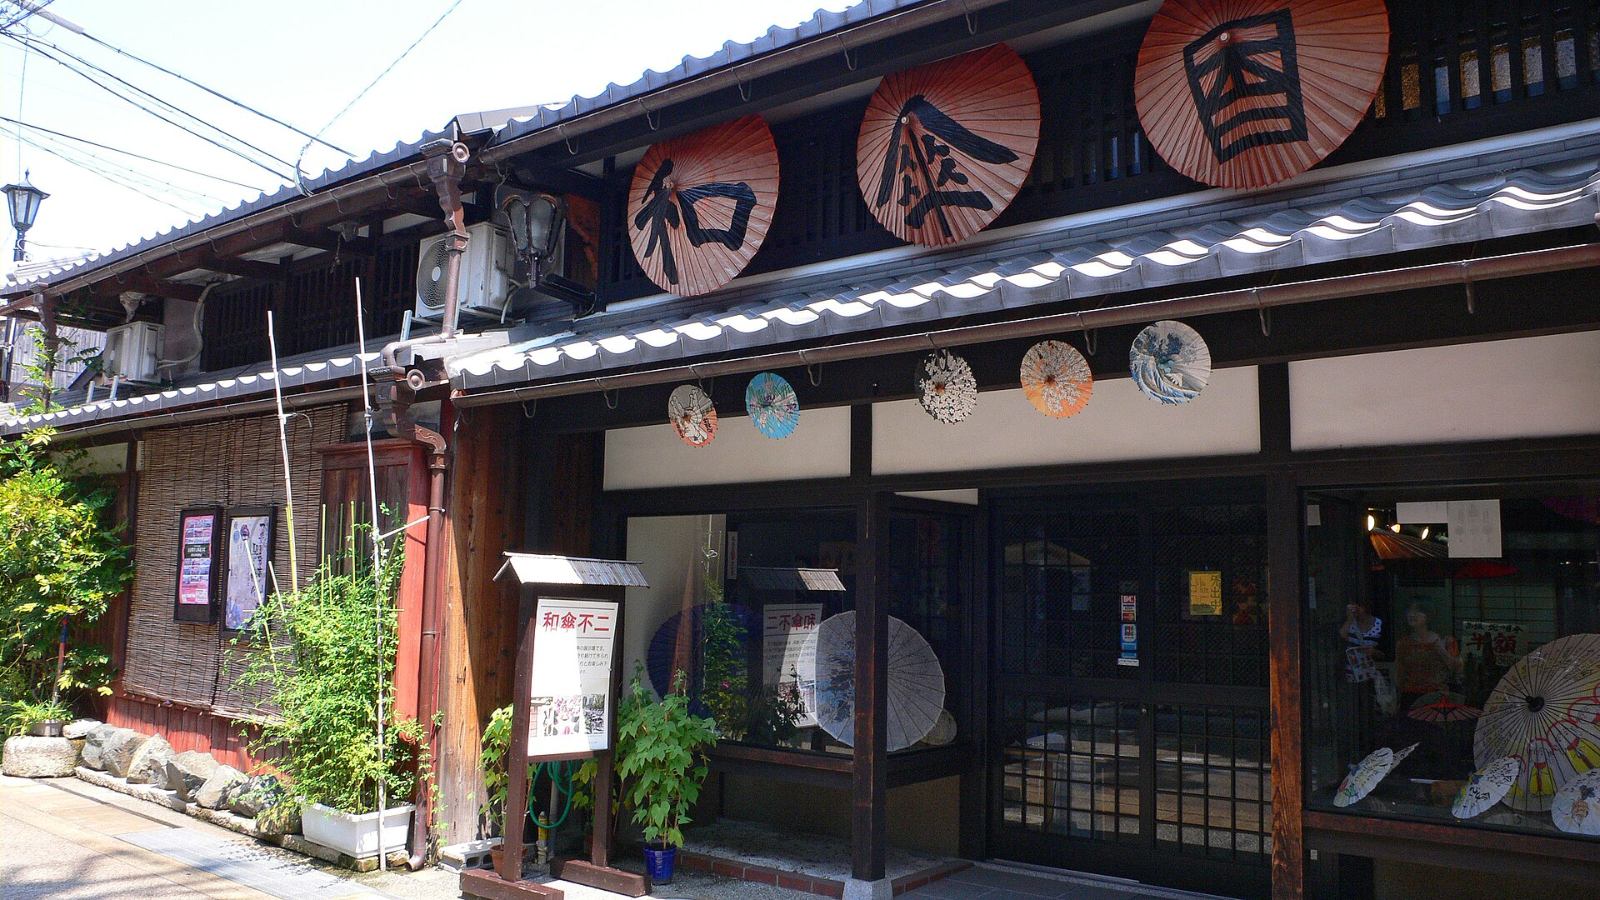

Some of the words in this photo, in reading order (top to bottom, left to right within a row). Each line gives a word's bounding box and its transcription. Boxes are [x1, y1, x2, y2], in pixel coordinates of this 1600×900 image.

[634, 157, 757, 285] 和
[877, 93, 1020, 238] 傘
[543, 611, 609, 633] 和傘不二
